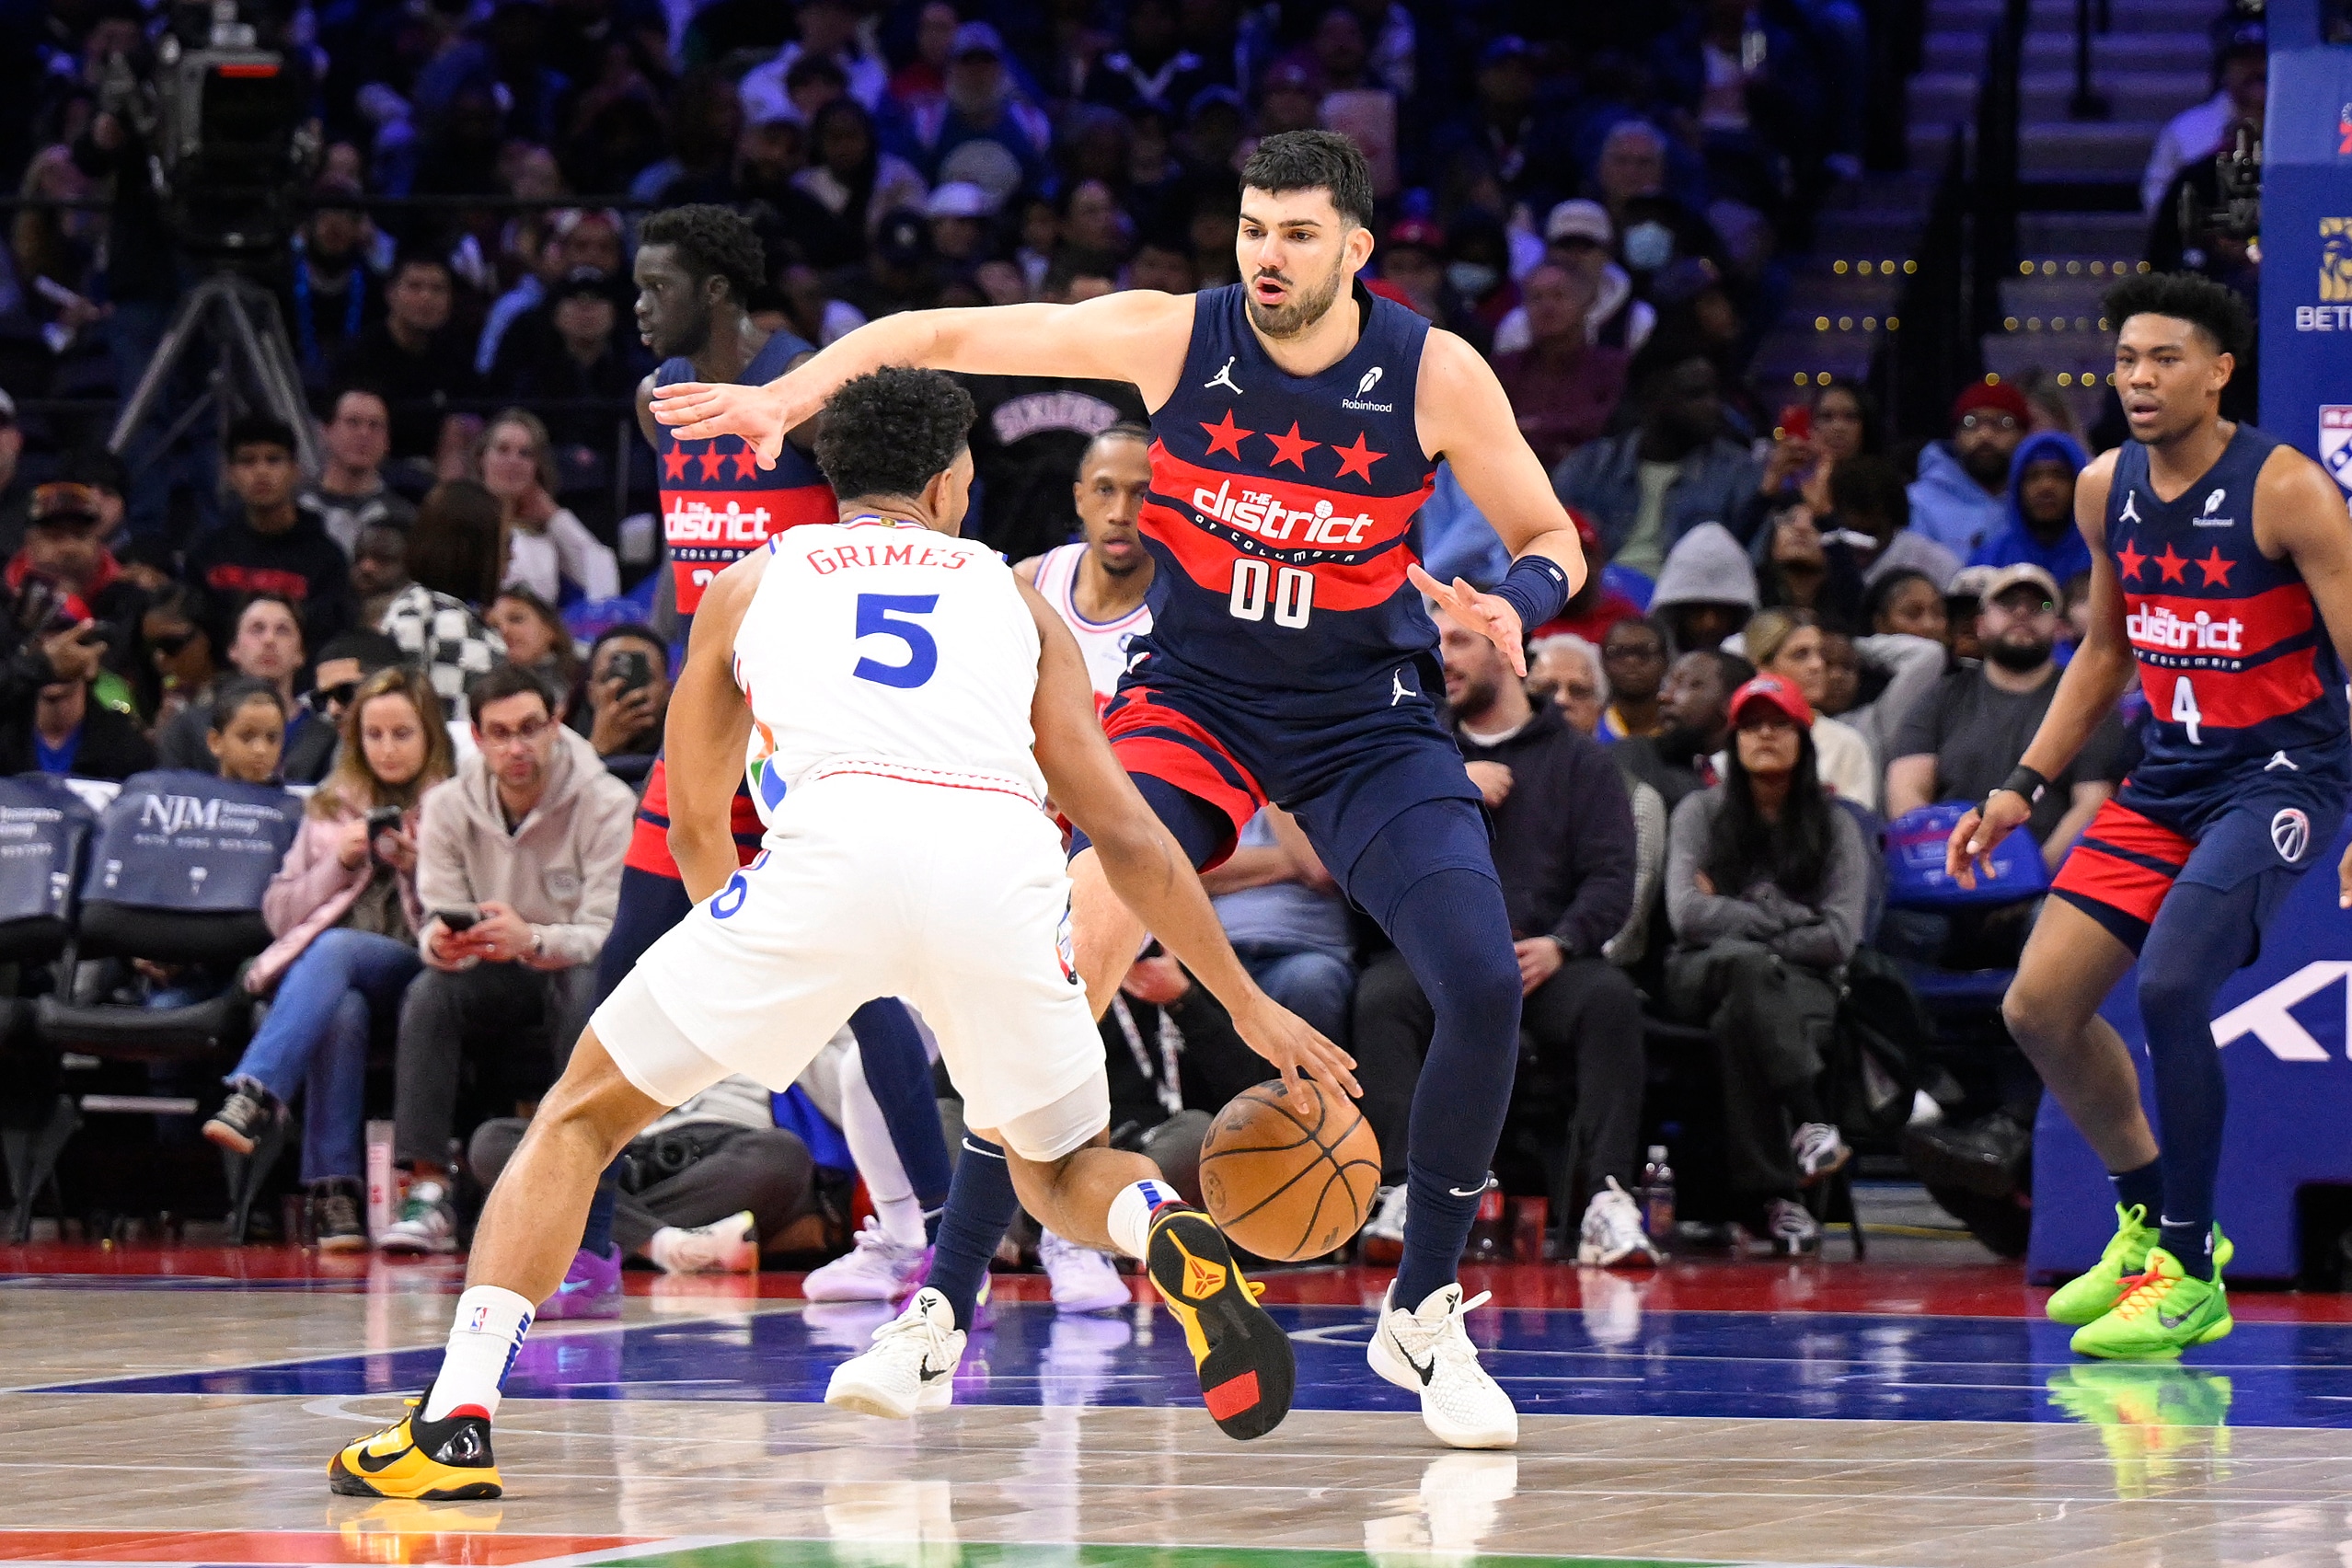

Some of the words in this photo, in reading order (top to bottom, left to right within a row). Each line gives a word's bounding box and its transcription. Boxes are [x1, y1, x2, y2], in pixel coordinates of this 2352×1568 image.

[2296, 306, 2352, 332] BET
[1342, 398, 1392, 413] Robinhood
[664, 495, 771, 541] district
[1193, 478, 1375, 545] district
[1241, 490, 1273, 506] THE
[1194, 513, 1217, 531] OF
[806, 544, 975, 575] GRIMES
[1229, 558, 1314, 630] 00
[852, 593, 940, 689] 5
[2126, 601, 2244, 652] district
[2172, 674, 2203, 746] 4
[140, 793, 222, 836] NJM
